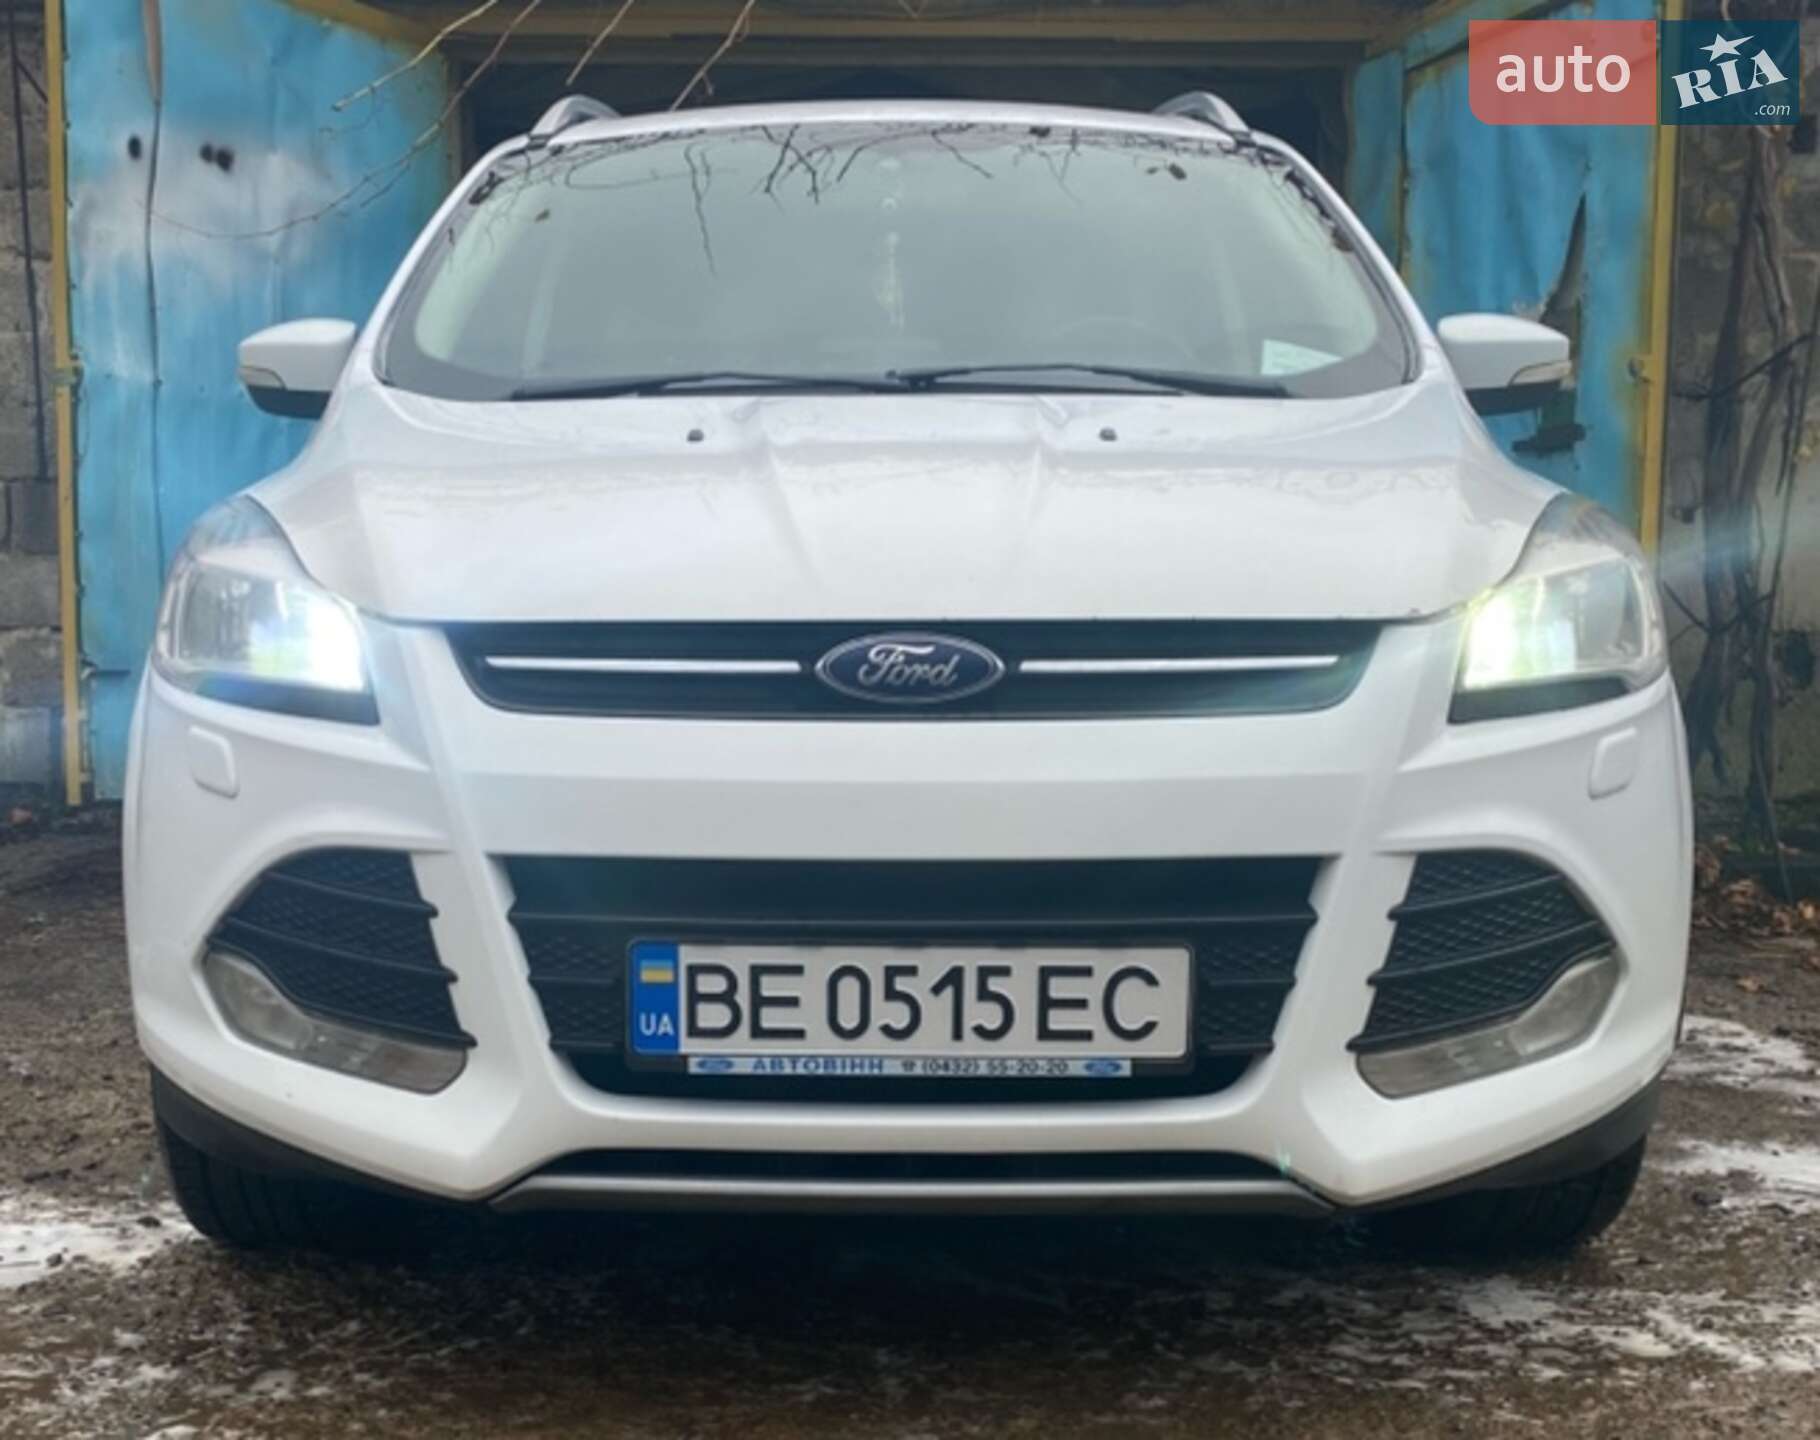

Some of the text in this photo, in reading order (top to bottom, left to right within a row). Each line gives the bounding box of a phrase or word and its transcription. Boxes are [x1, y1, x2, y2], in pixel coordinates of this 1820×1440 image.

[857, 643, 961, 687] Ford
[640, 1013, 674, 1036] UA
[686, 963, 1161, 1042] BE 0515 EC
